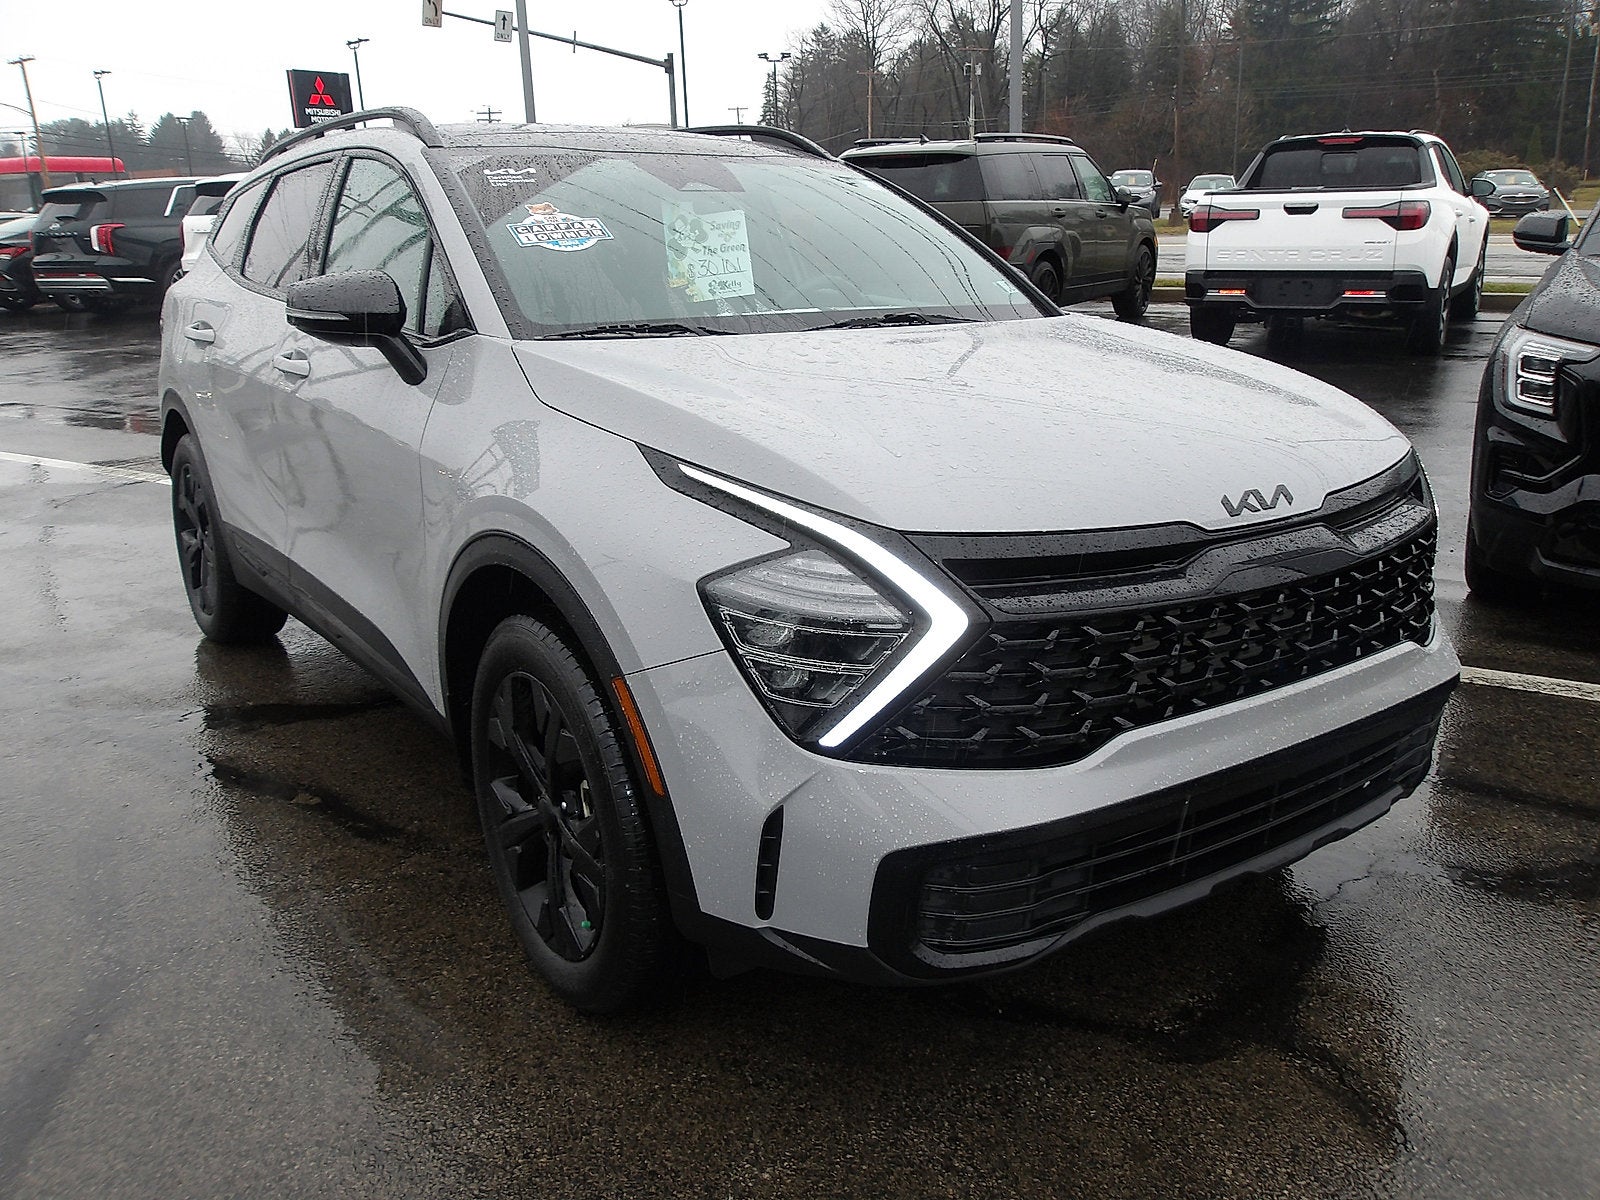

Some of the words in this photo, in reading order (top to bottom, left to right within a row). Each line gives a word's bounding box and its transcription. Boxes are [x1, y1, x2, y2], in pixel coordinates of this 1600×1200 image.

[424, 17, 440, 25] ONLY
[305, 107, 341, 116] MITSUBISHI
[514, 221, 598, 234] CARFAX
[710, 221, 741, 231] Saving
[535, 229, 607, 241] OWNER
[702, 245, 718, 256] The
[720, 243, 746, 253] Green
[1216, 250, 1301, 262] SANTA
[1308, 249, 1383, 261] CRUZ
[1220, 484, 1294, 517] KIA
